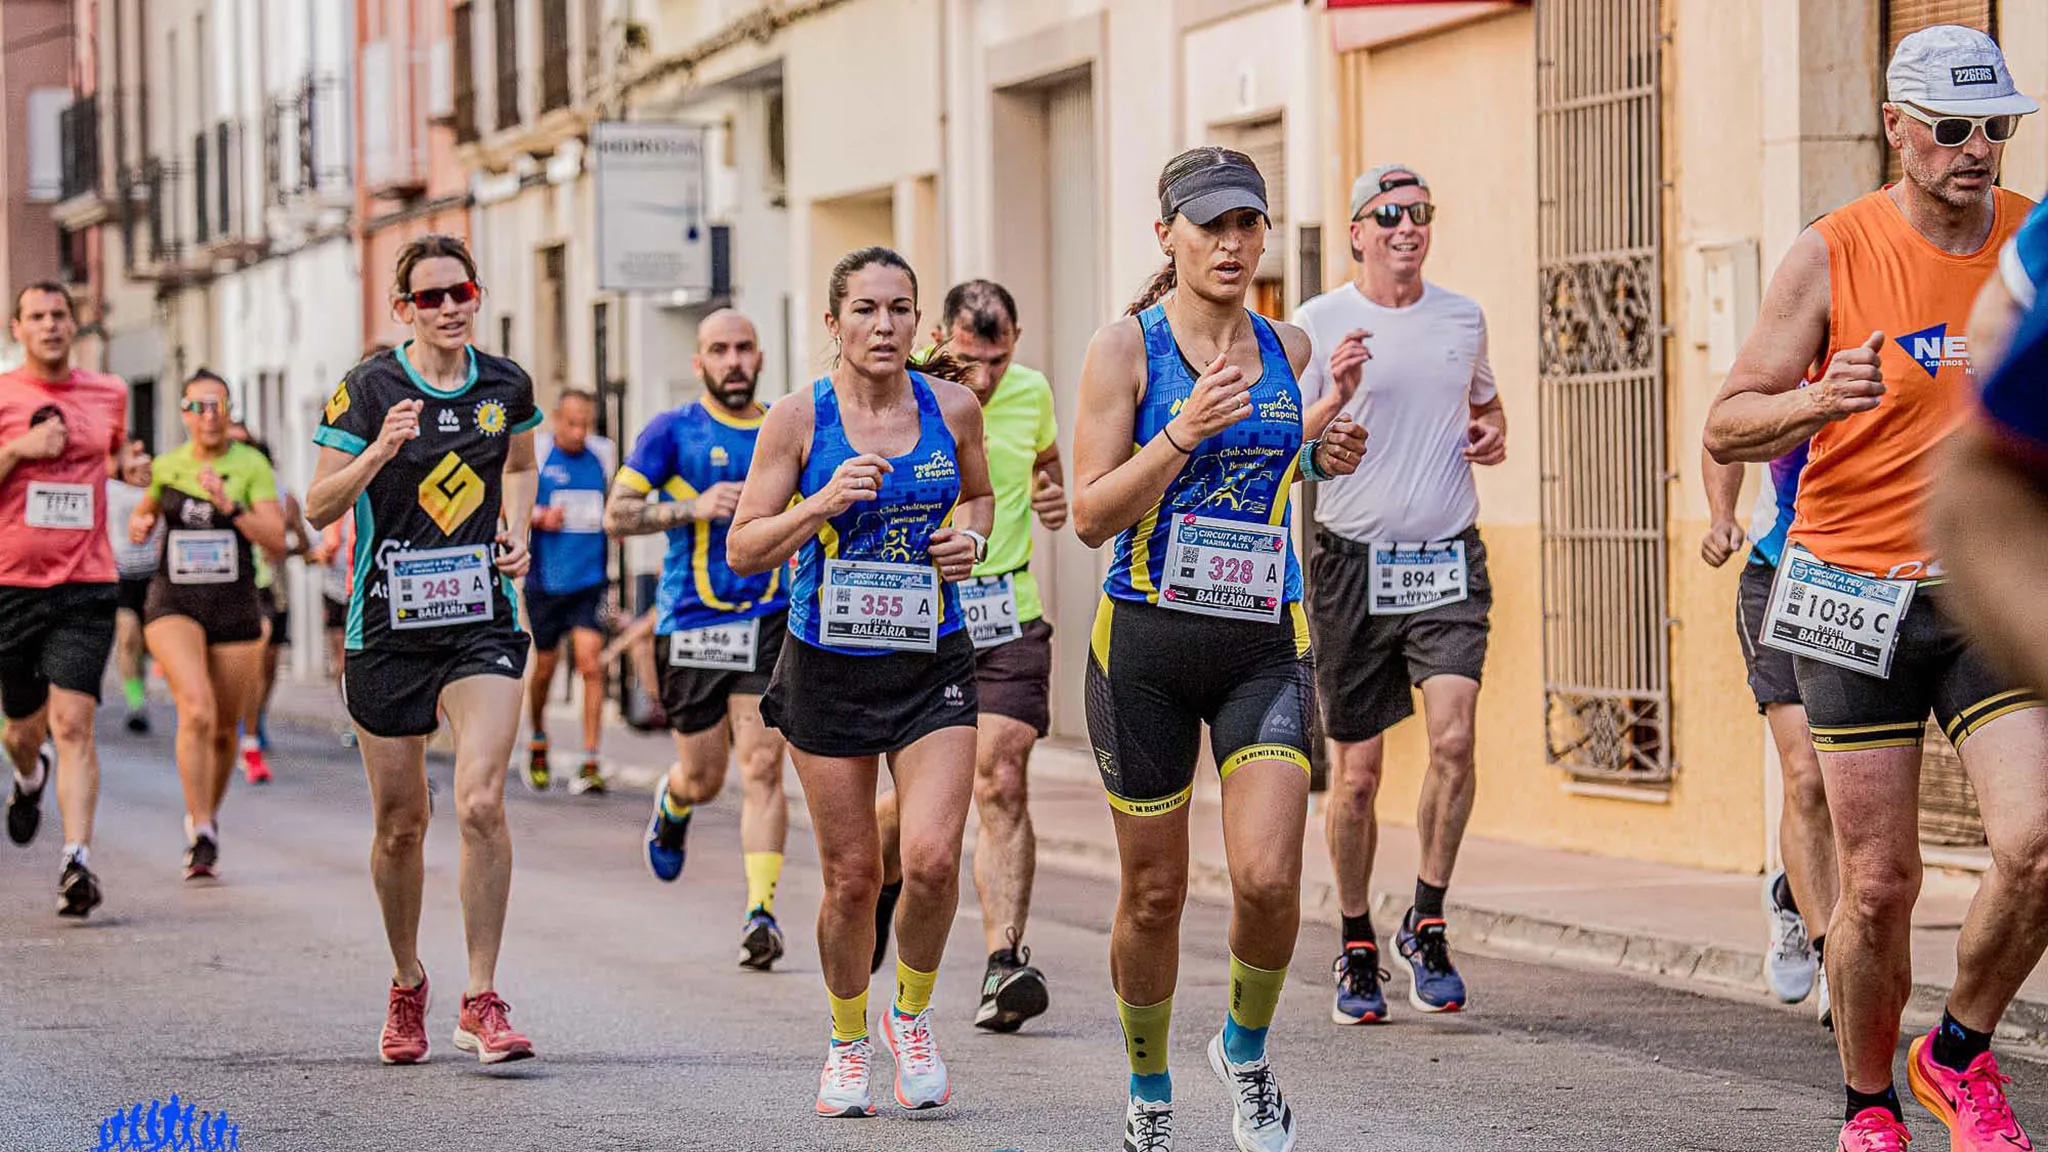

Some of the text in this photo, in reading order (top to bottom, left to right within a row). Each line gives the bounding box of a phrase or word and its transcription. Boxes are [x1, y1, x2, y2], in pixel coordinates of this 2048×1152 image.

[1955, 68, 1992, 83] 226ERS
[1199, 530, 1231, 541] CIRCUIT
[1203, 539, 1249, 550] MARINA ALTA
[849, 572, 879, 582] CIRCUIT
[885, 573, 901, 581] PEU
[1208, 556, 1277, 584] 328 A
[1402, 568, 1459, 587] 894 C
[1809, 567, 1839, 581] CIRCUIT
[1845, 577, 1863, 587] PEU
[423, 576, 484, 599] 243 A
[853, 579, 880, 587] MARINA
[1212, 584, 1247, 594] VANESSA
[1811, 576, 1856, 594] MARINA ALTA
[861, 593, 930, 617] 355 A
[1002, 601, 1011, 615] C
[1808, 594, 1890, 634] 1036 C
[1818, 624, 1844, 639] RAFAEL
